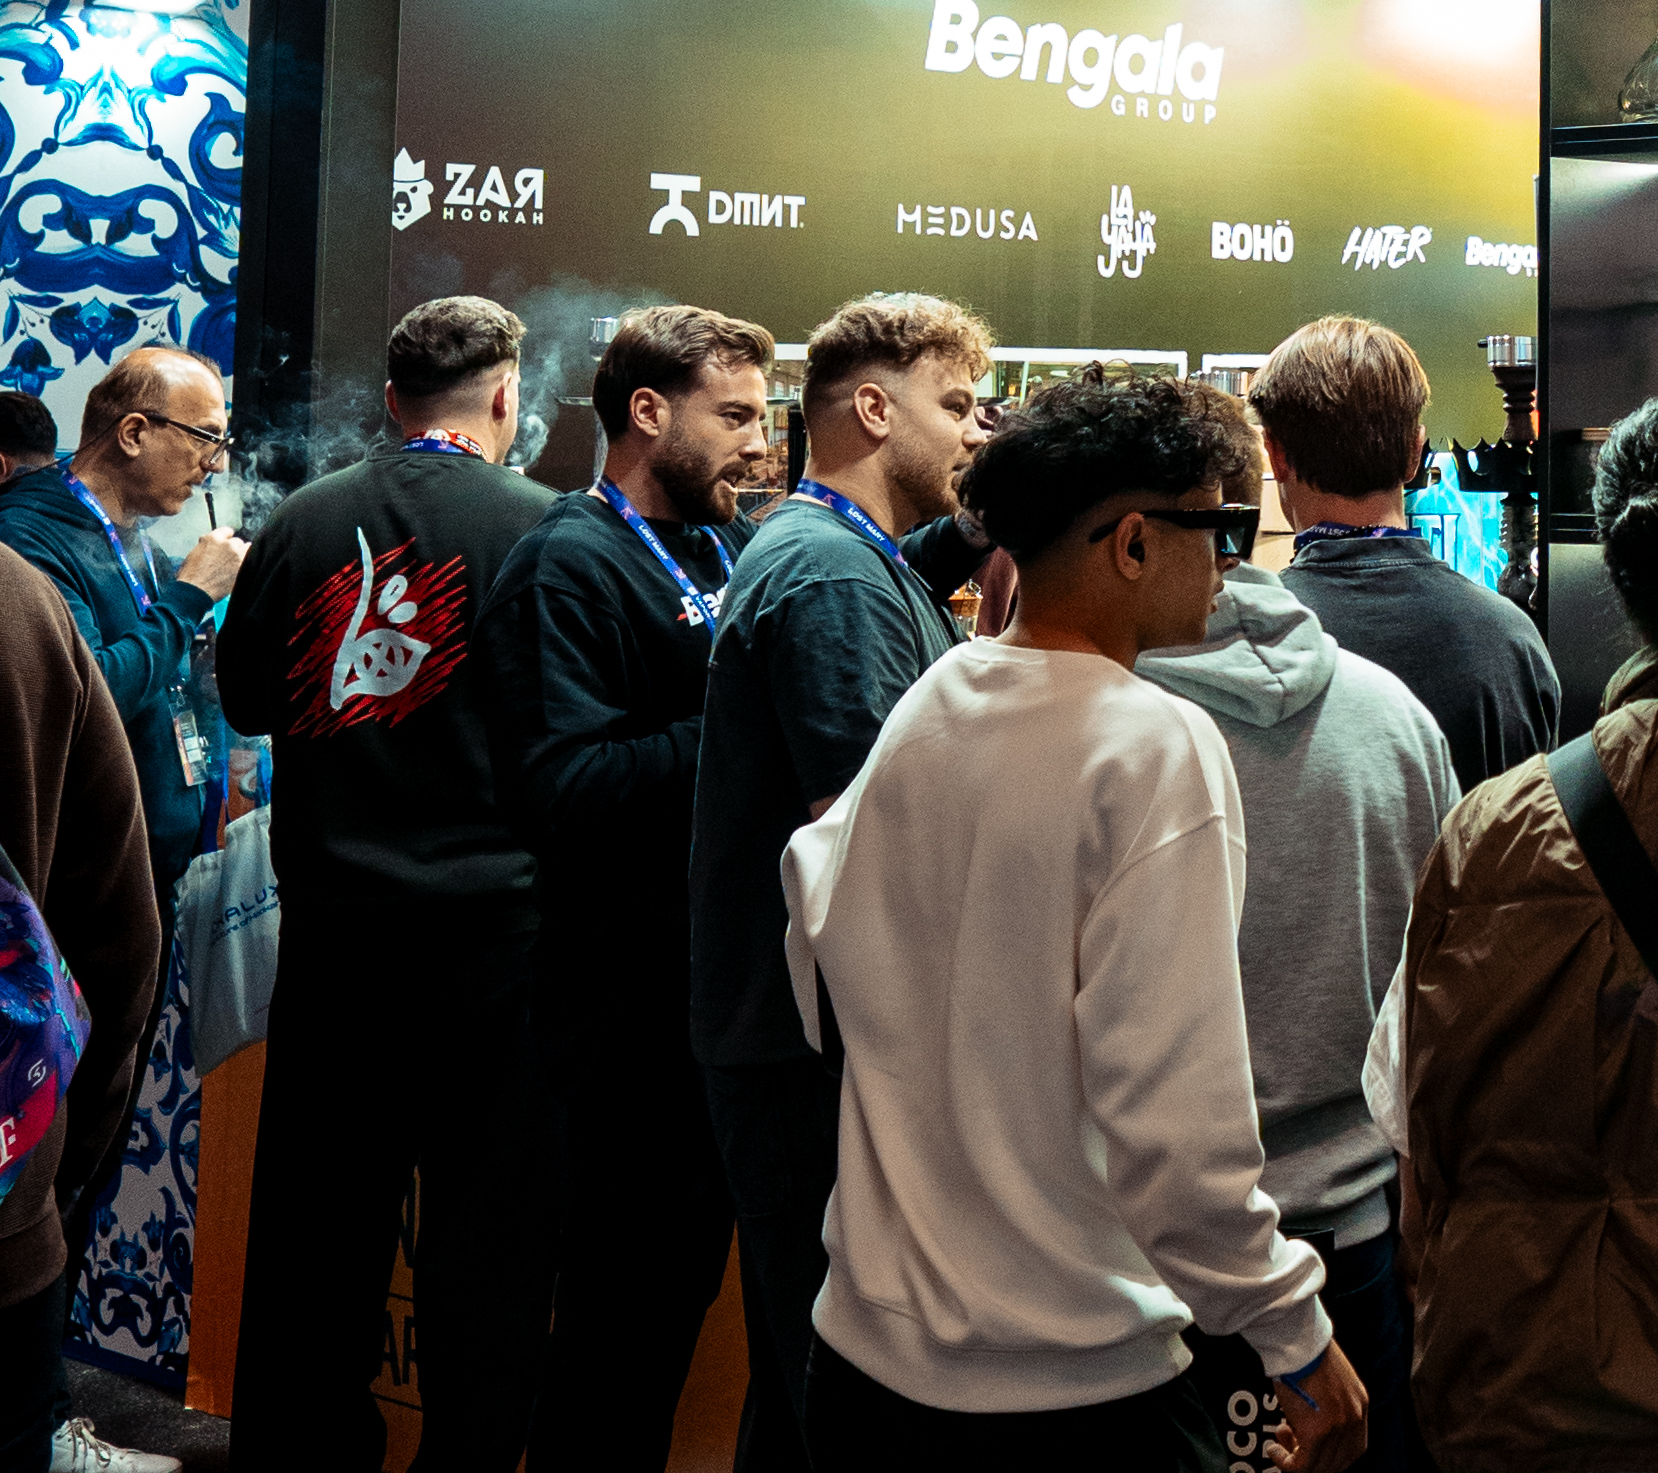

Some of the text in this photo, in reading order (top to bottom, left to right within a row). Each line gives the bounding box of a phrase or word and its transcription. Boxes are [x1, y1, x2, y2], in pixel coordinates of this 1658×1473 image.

[1110, 94, 1218, 125] GROUP
[443, 206, 544, 226] HOOKAH
[896, 202, 1039, 242] MEDUSA
[638, 524, 669, 560] LOST MARY
[847, 507, 886, 543] LOST MARY
